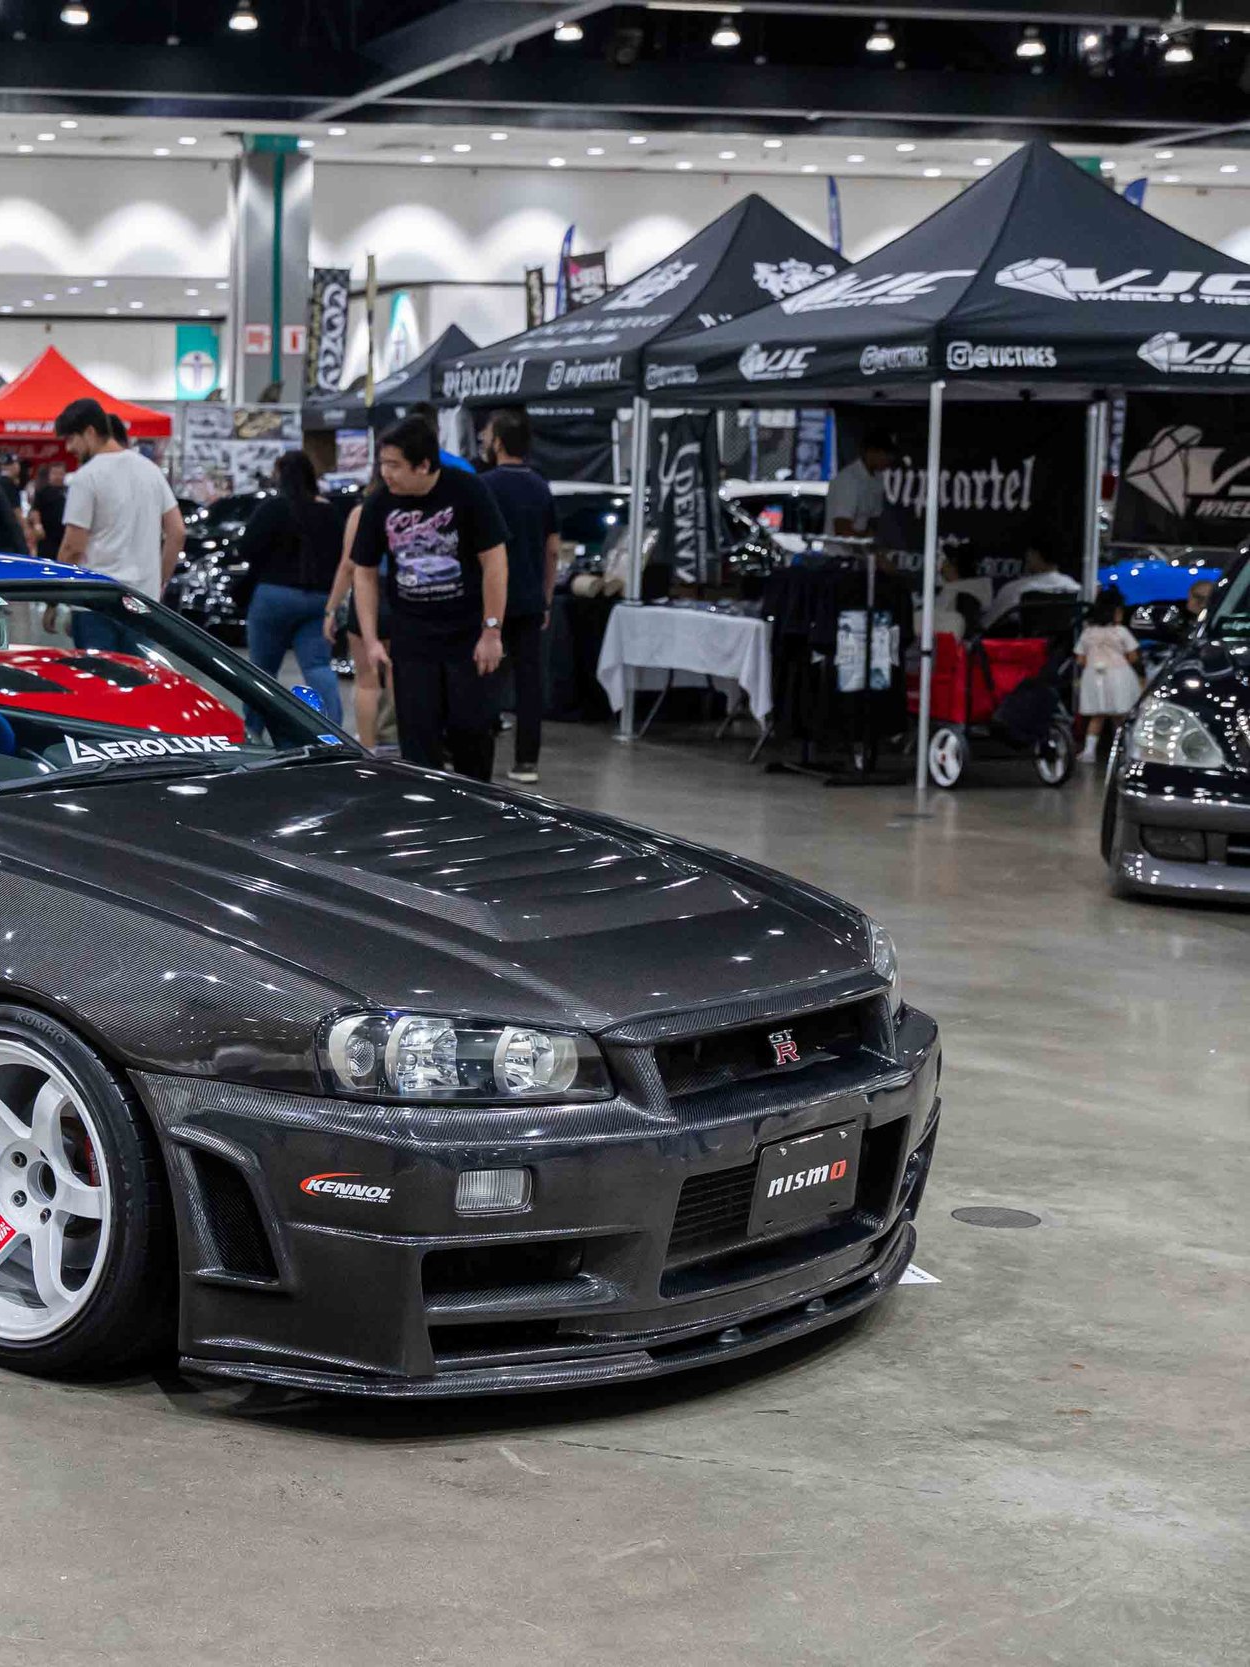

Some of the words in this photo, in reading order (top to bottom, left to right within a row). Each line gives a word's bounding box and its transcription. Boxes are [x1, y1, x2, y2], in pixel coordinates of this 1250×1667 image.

[1078, 291, 1175, 303] WHEELS
[64, 734, 241, 765] AEROLUXE
[13, 1011, 68, 1046] KUMHO
[768, 1029, 793, 1044] GT
[774, 1040, 801, 1066] R
[305, 1179, 392, 1200] KENNOL
[767, 1159, 847, 1198] nismo
